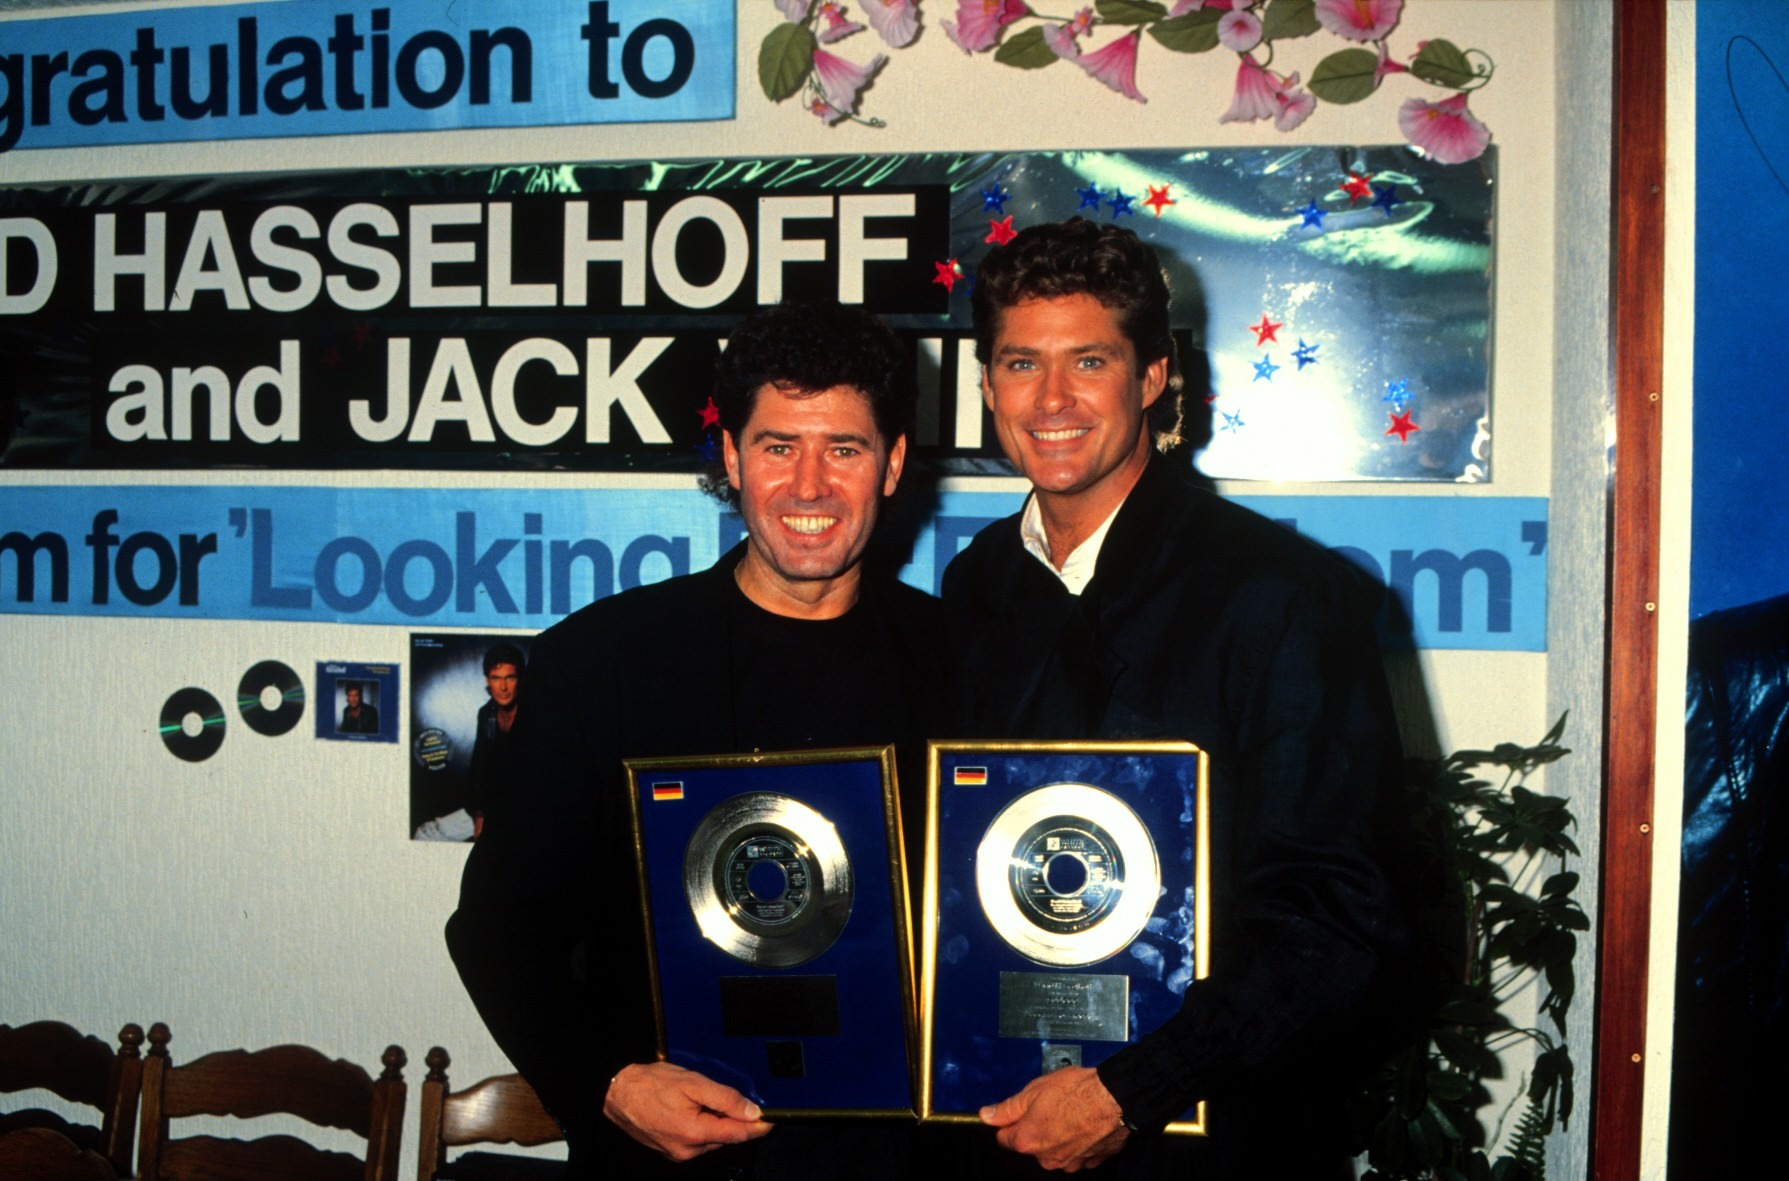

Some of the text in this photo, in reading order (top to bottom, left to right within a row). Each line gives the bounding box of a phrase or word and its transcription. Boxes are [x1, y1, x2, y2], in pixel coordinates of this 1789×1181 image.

[581, 1, 695, 100] to
[0, 194, 916, 314] D HASSELHOFF
[105, 340, 300, 442] and
[348, 337, 675, 446] JACK
[85, 509, 217, 606] for
